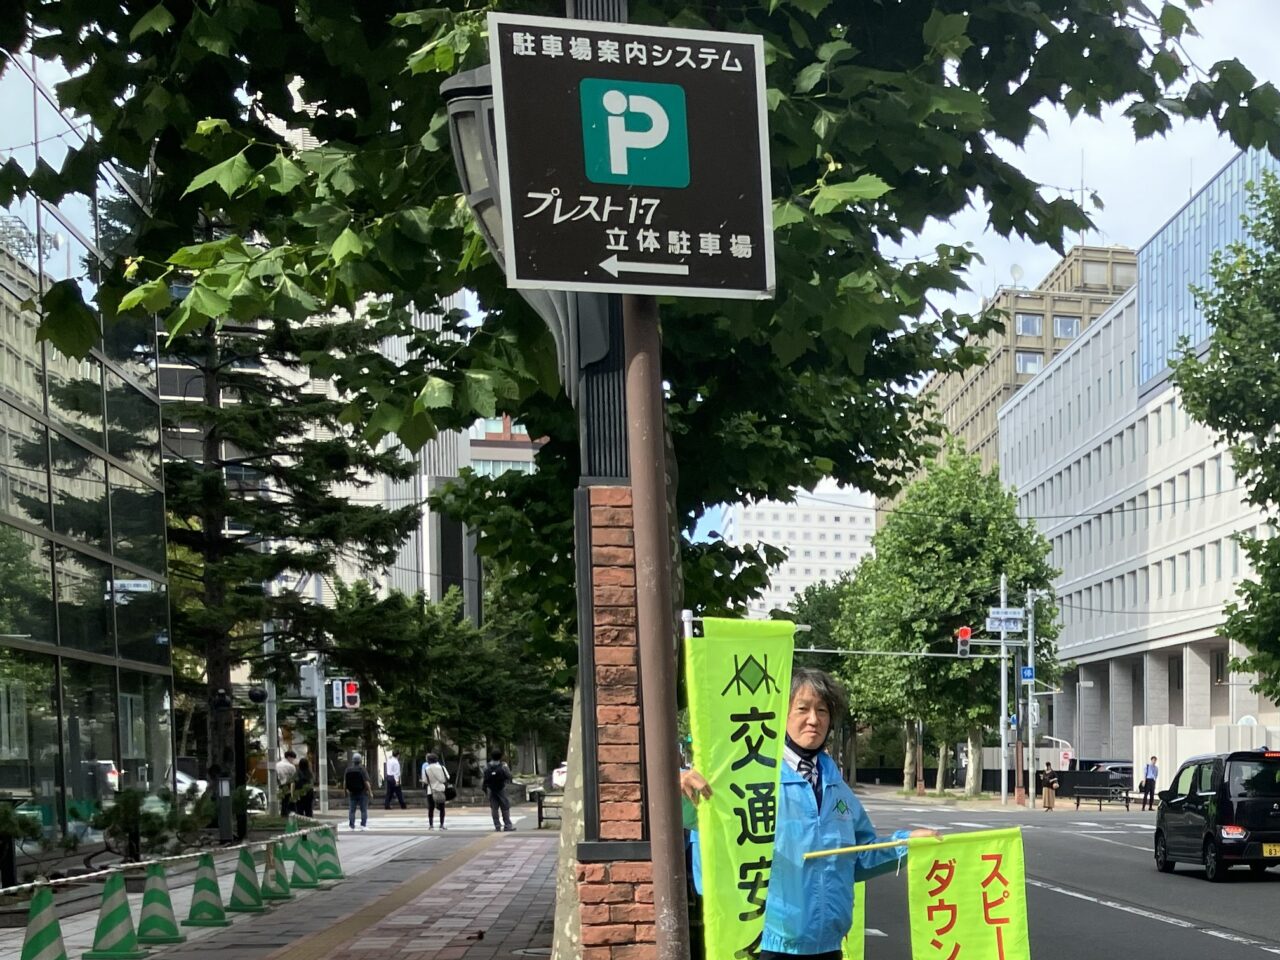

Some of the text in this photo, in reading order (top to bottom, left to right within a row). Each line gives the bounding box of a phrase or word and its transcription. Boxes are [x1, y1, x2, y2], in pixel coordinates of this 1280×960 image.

[512, 32, 743, 72] 駐車場案内システム
[606, 227, 753, 259] 立体駐車場
